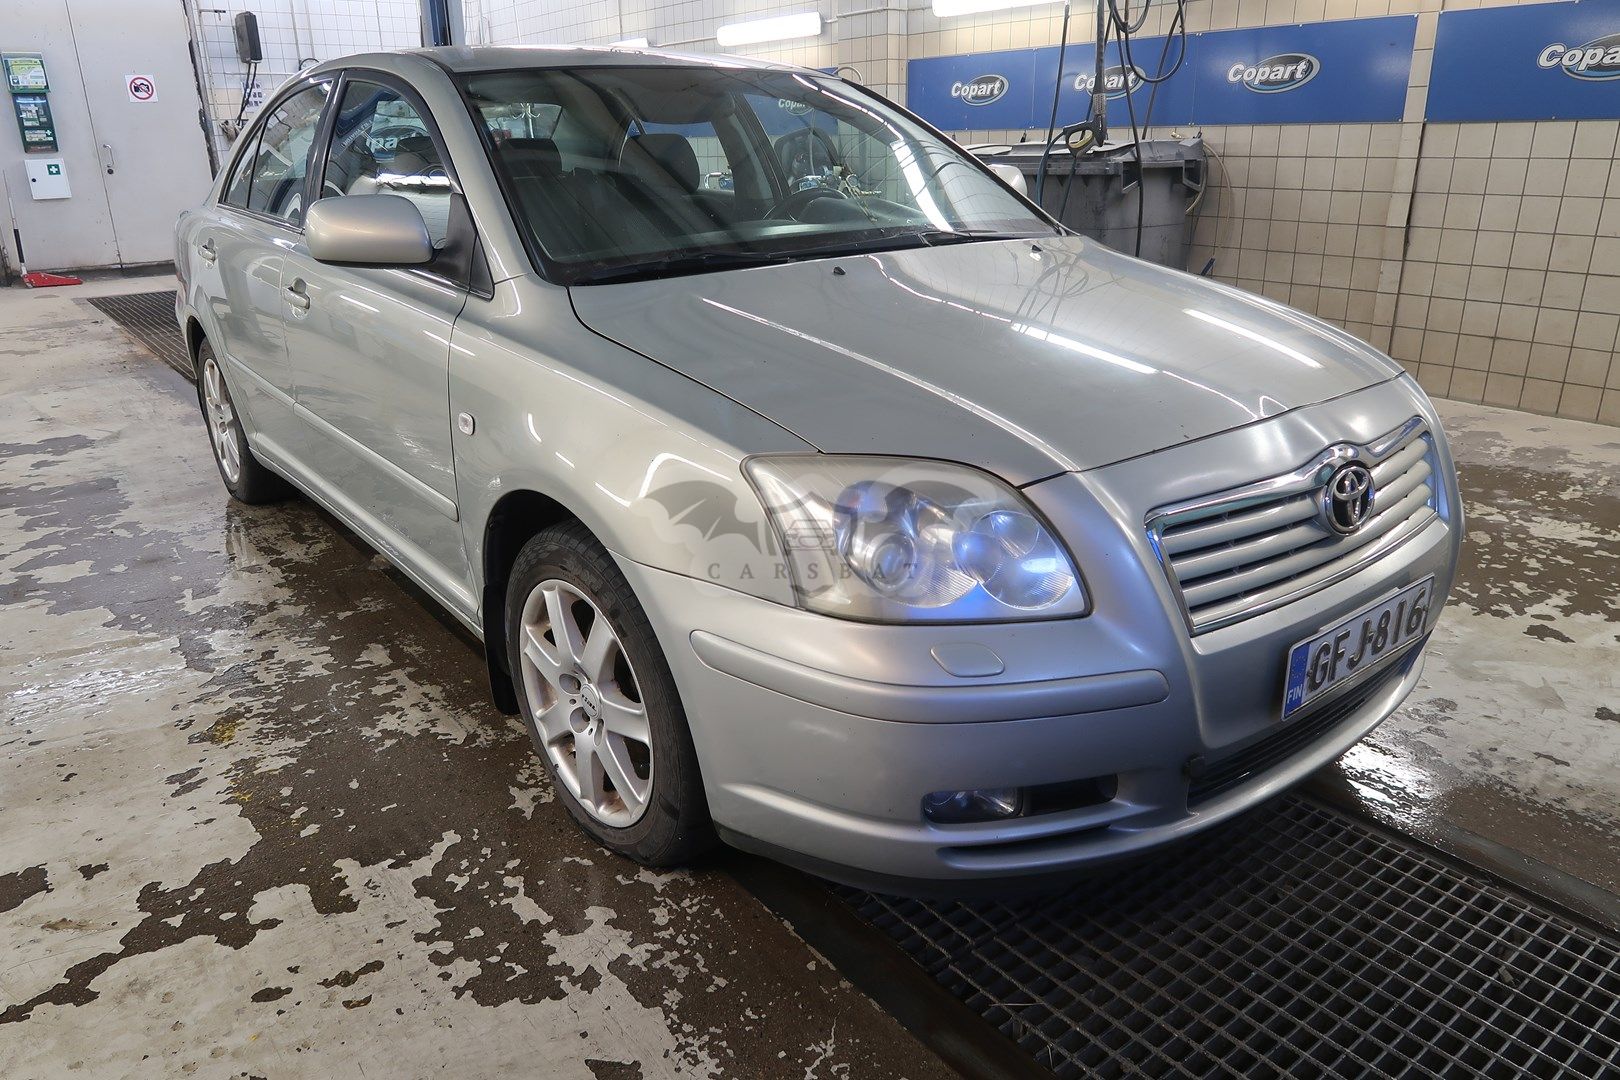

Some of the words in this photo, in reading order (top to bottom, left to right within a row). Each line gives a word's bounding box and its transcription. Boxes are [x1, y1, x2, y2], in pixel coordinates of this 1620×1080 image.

[1074, 71, 1136, 90] Coart
[1228, 60, 1307, 85] Copart
[951, 78, 1002, 99] Copart
[1308, 587, 1426, 693] GFJ-816
[1287, 683, 1304, 704] FIN
